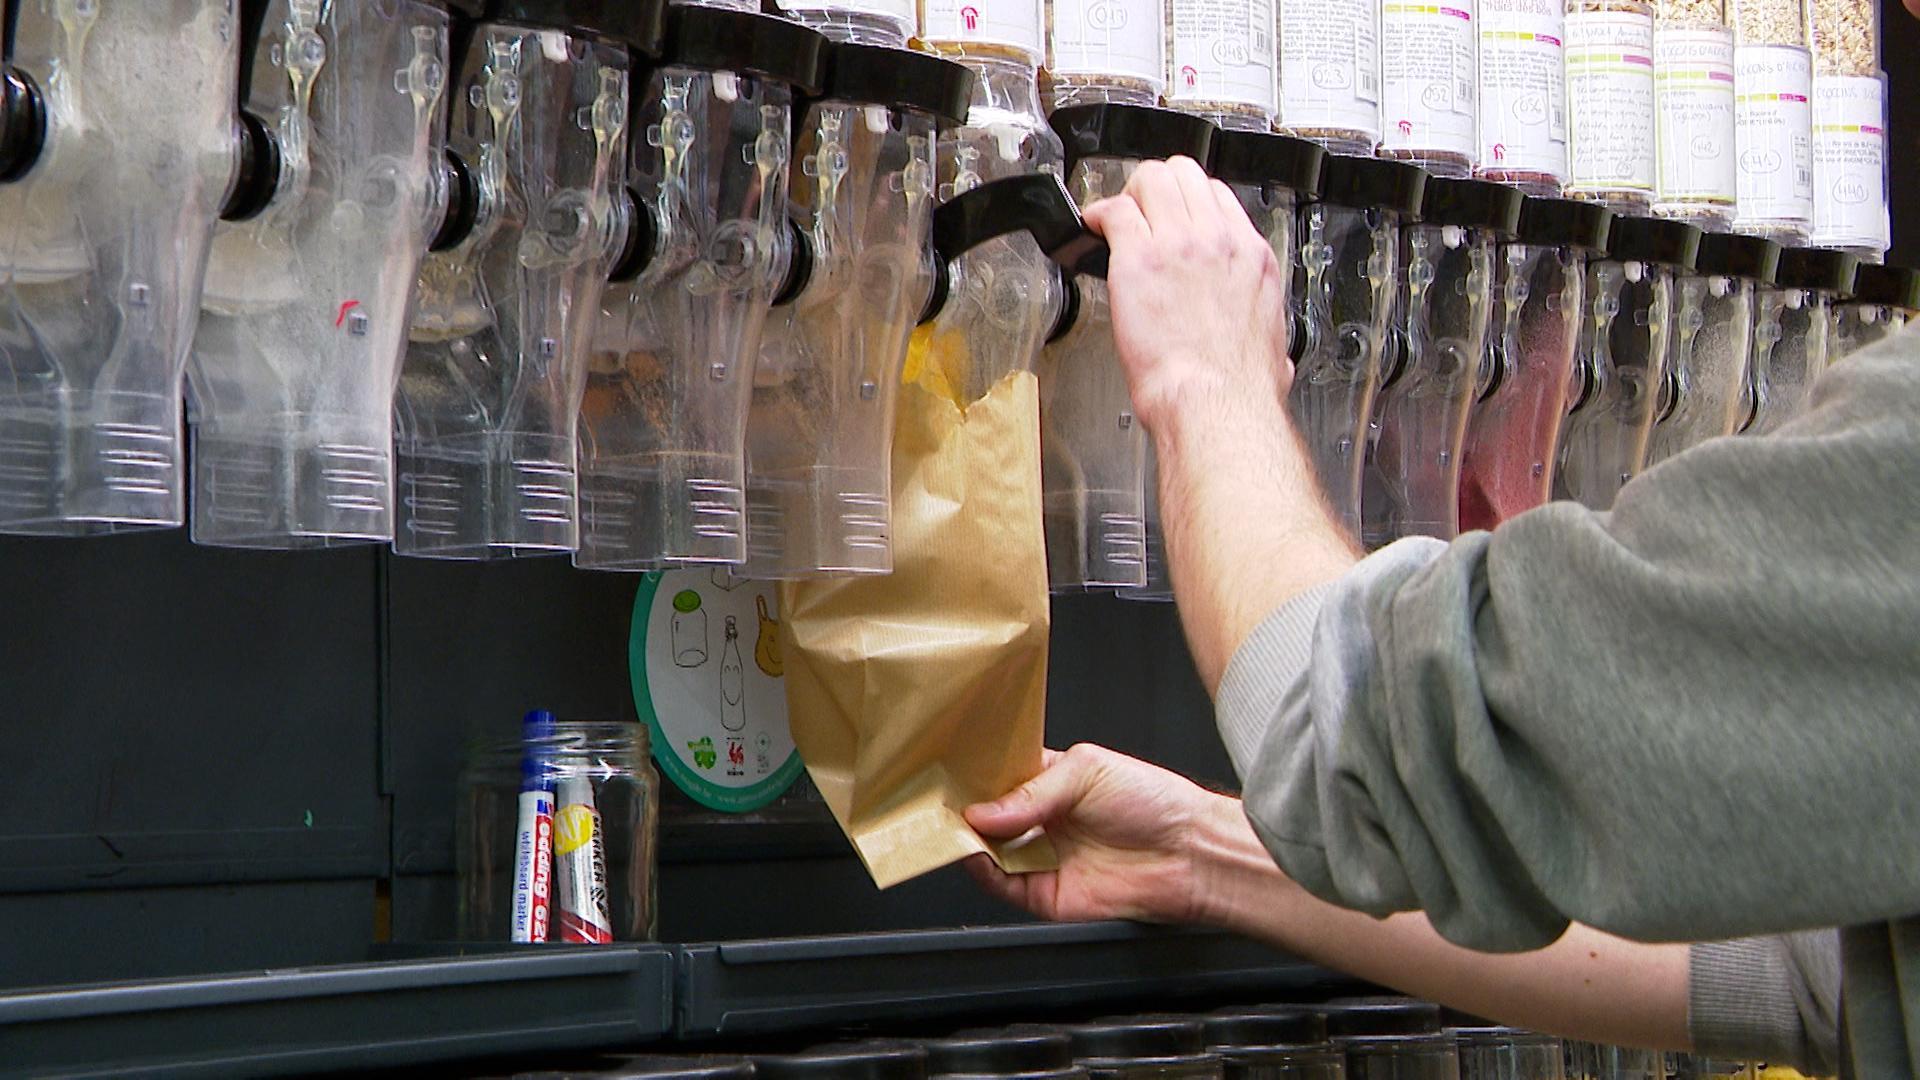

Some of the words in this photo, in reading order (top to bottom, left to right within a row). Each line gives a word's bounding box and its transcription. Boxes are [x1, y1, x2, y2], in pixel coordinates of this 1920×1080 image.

[519, 831, 531, 890] whiteboard
[534, 823, 550, 899] edding
[517, 893, 529, 931] marker
[534, 905, 547, 943] 62
